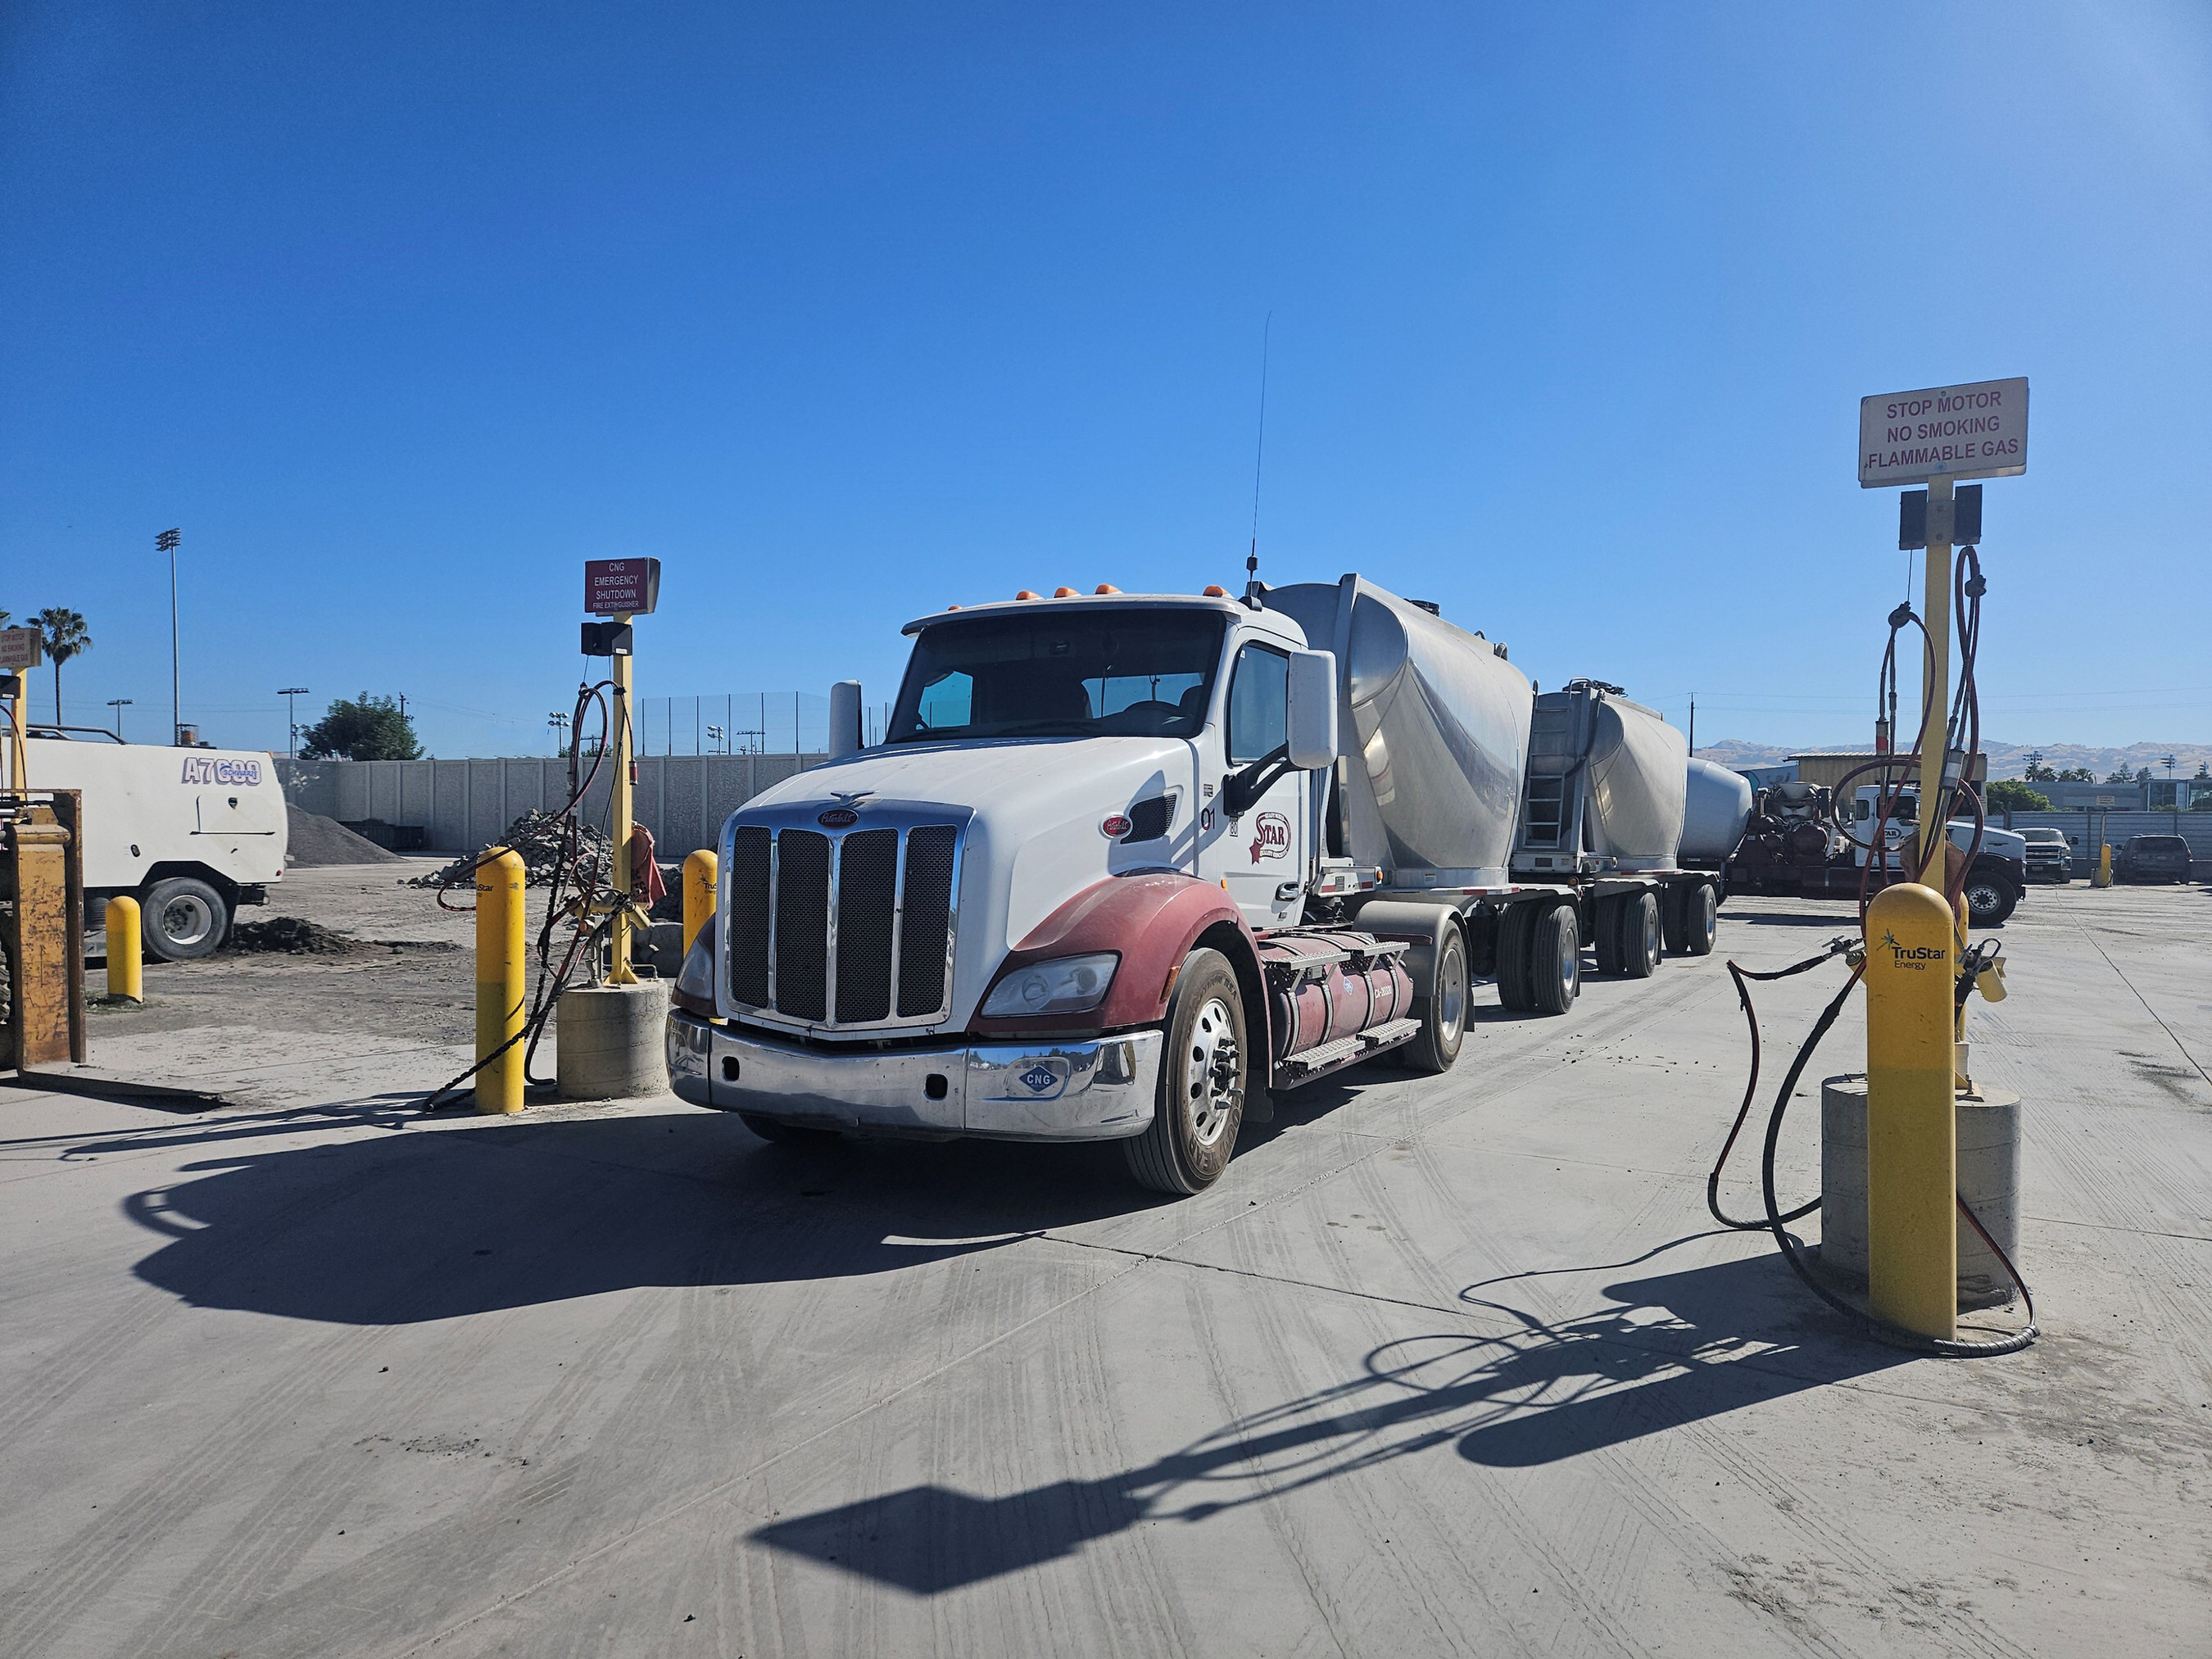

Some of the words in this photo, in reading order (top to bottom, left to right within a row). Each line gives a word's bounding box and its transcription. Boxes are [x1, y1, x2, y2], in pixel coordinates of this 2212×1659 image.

[1886, 399, 1933, 419] STOP
[1938, 391, 2001, 413] MOTOR
[1887, 425, 1912, 443] NO
[1917, 415, 2000, 440] SMOKING
[1868, 442, 1976, 469] FLAMMABLE
[1981, 438, 2019, 456] GAS
[609, 562, 625, 572] CNG
[594, 574, 639, 587] EMERGENCY
[596, 589, 637, 600] SHUTDOWN
[604, 600, 640, 609] EXTINGUISHER
[821, 812, 855, 823] Peterbilt
[1200, 808, 1216, 831] 01
[1107, 819, 1129, 832] Peterbilt
[1256, 820, 1285, 845] STAR
[1891, 946, 1946, 959] TruStar
[1894, 960, 1926, 971] Energy
[1027, 1074, 1050, 1085] CNG
